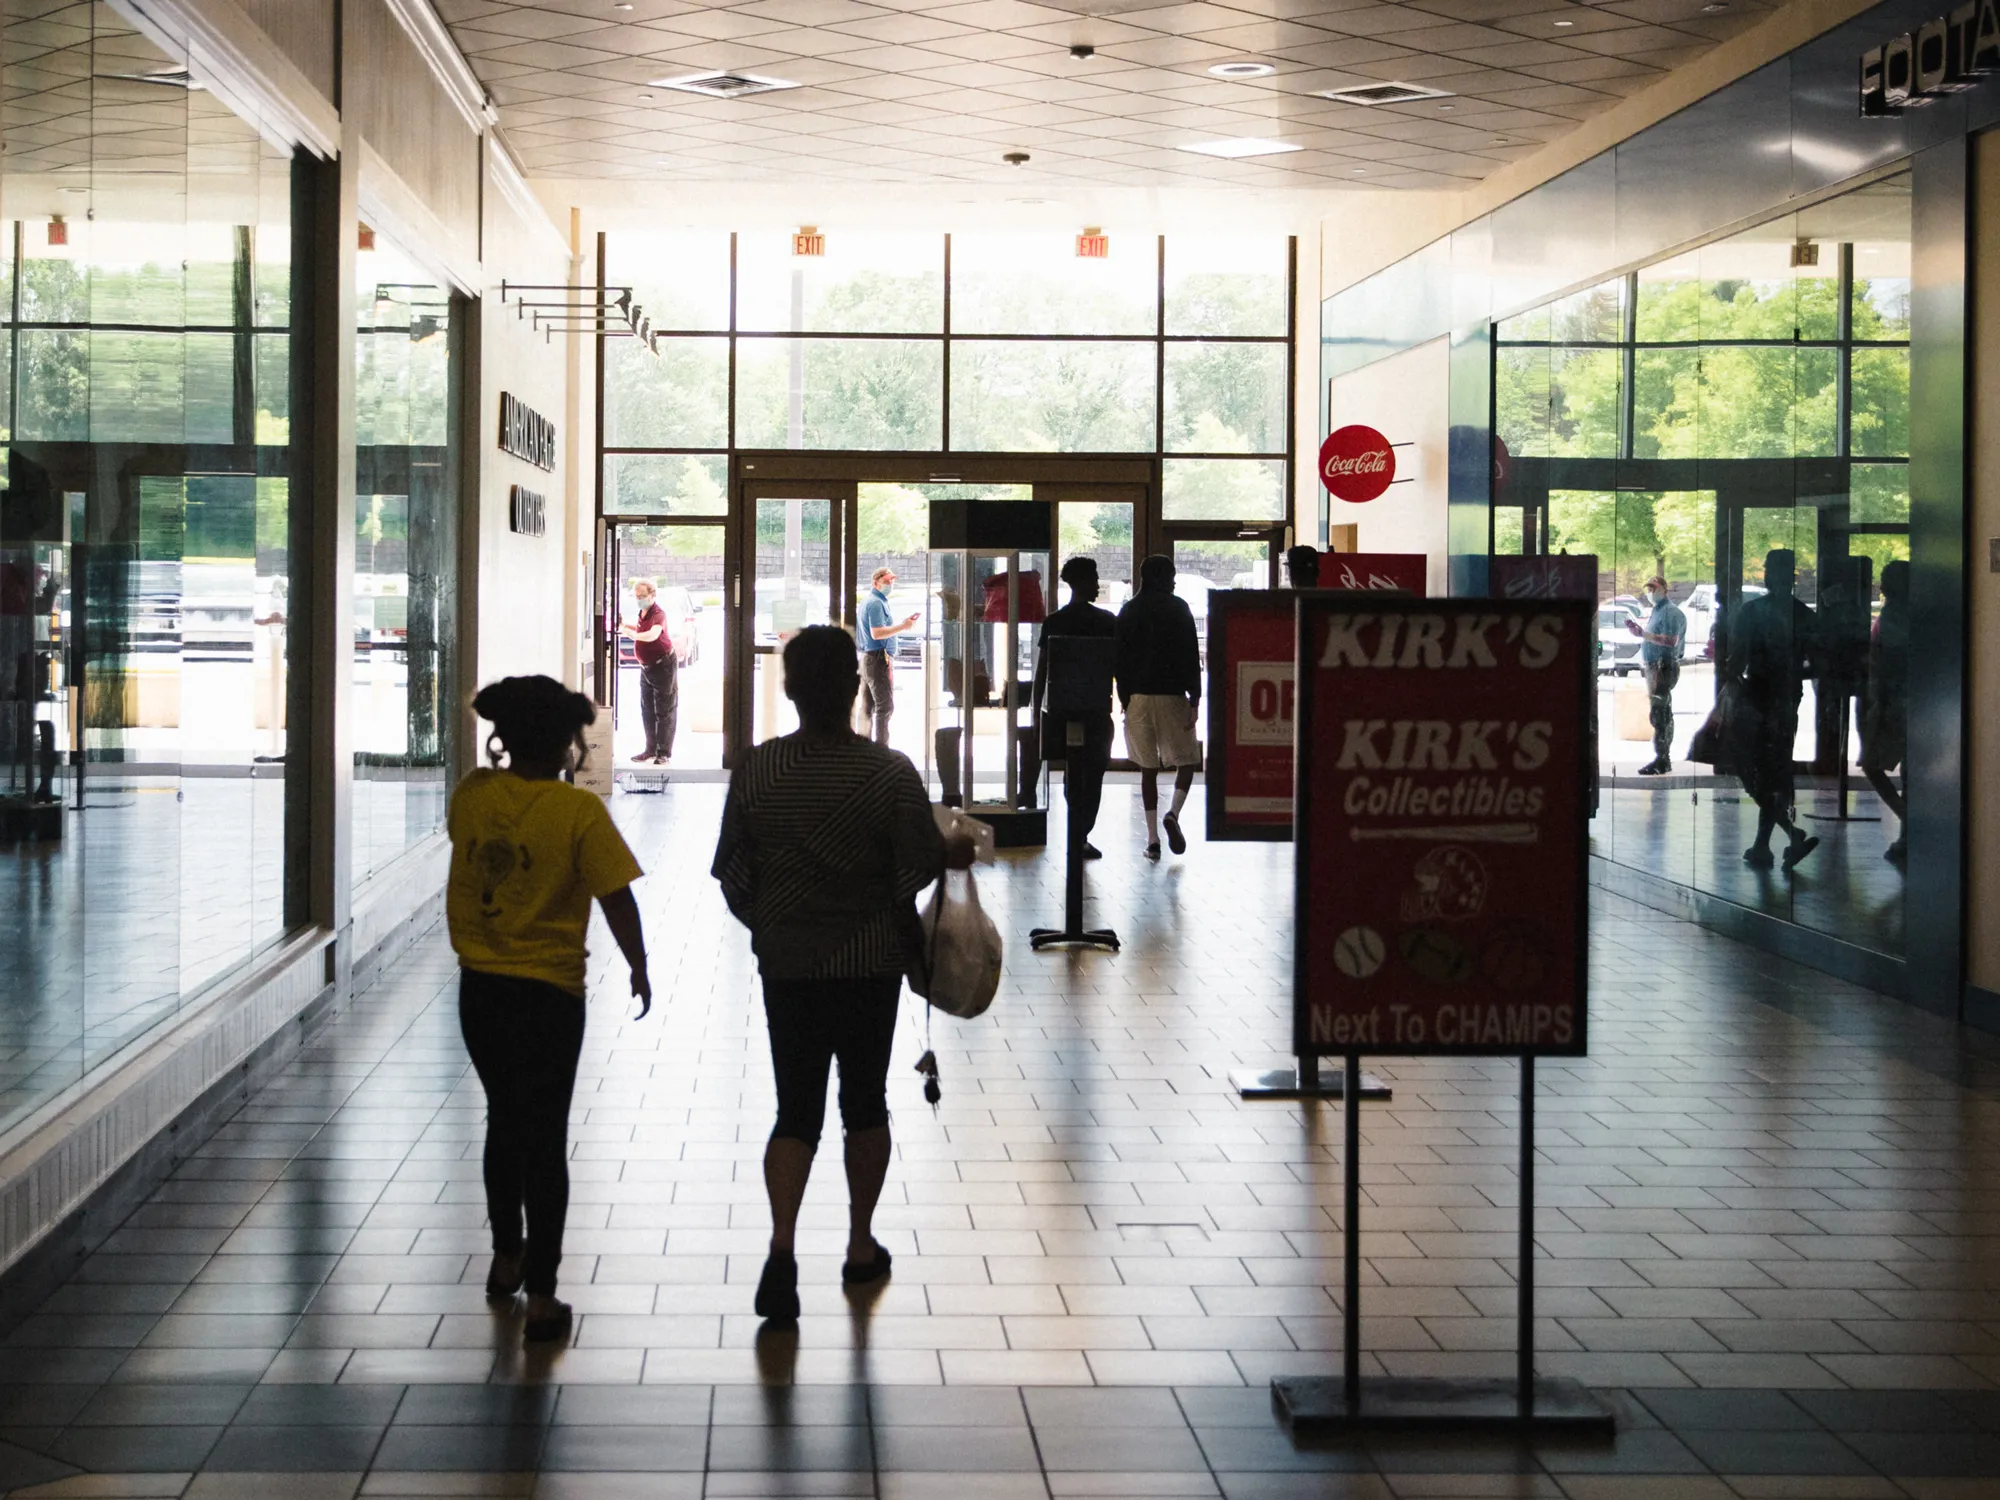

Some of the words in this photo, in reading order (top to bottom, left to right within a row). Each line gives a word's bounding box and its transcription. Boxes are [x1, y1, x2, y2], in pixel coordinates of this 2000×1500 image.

[796, 236, 822, 255] EXIT
[1080, 237, 1105, 256] EXIT
[1325, 450, 1389, 478] Coca-Cola
[1319, 614, 1564, 669] KIRK'S
[1336, 720, 1553, 771] KIRK'S
[1344, 776, 1544, 817] Collectibles
[1310, 1003, 1380, 1045] Next
[1388, 1004, 1425, 1045] To
[1436, 1004, 1574, 1045] CHAMPS
